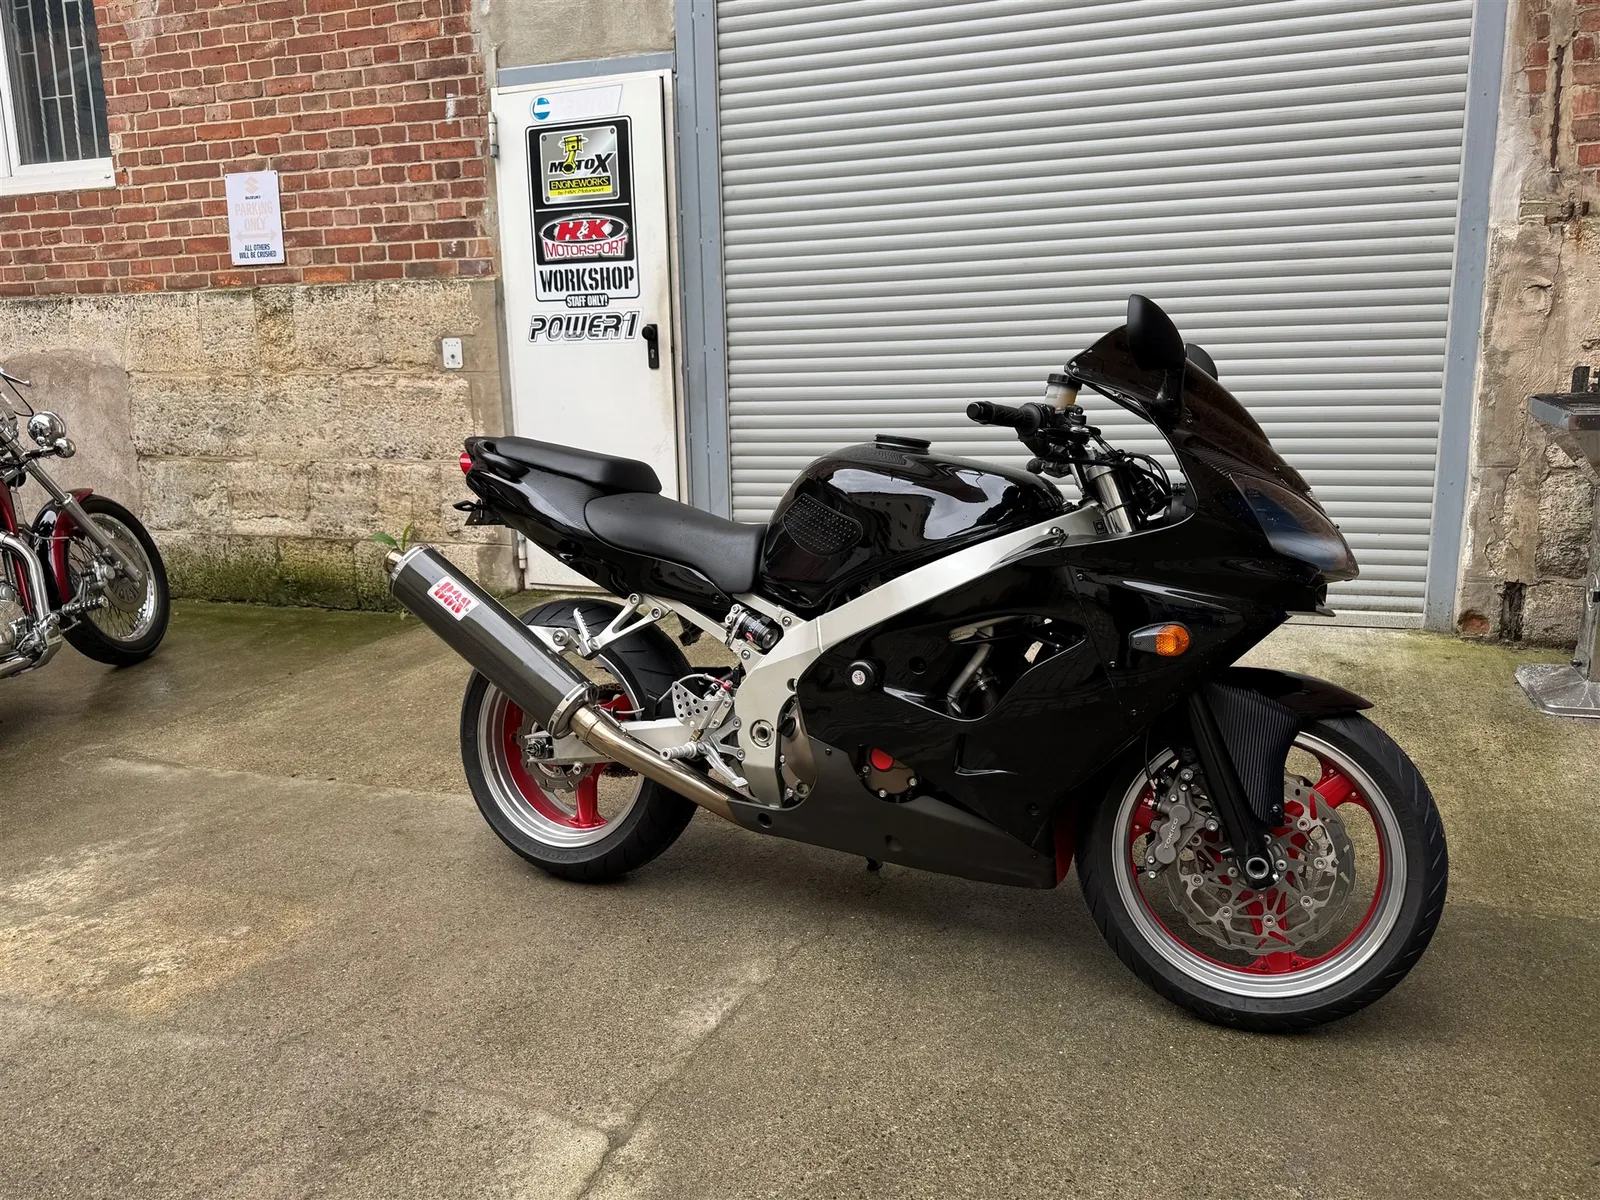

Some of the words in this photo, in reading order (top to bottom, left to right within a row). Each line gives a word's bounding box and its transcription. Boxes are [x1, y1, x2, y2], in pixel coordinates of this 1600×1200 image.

[551, 177, 609, 190] ENGINEWORKS
[234, 200, 273, 216] PARKING
[244, 217, 266, 231] ONLY
[555, 219, 610, 241] H&K
[254, 243, 270, 251] OTHERS
[257, 250, 277, 258] CRUSHED
[544, 237, 627, 258] MOTORSPORT
[539, 266, 634, 293] WORKSHOP
[567, 295, 586, 307] STAFF
[587, 294, 608, 306] ONLY!
[529, 312, 639, 341] POWER1
[1164, 818, 1178, 849] TOKICO
